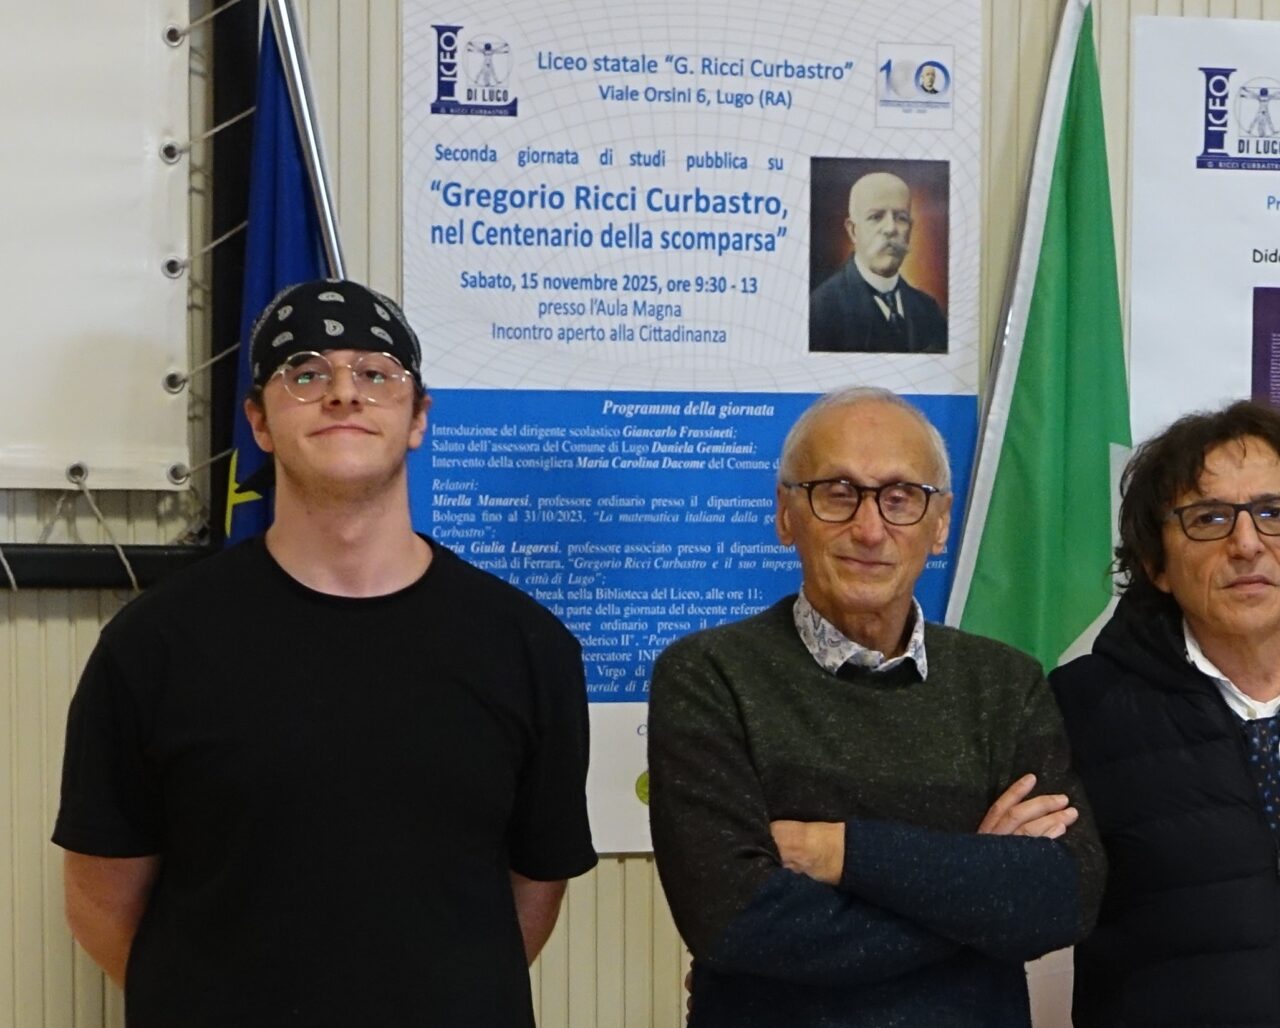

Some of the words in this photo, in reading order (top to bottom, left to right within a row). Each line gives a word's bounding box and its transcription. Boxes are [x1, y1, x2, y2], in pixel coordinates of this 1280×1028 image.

[538, 51, 588, 71] Liceo
[593, 53, 658, 74] statale
[701, 57, 744, 77] Ricci
[751, 59, 854, 80] Curbastro"
[466, 88, 477, 101] DI
[482, 88, 509, 102] LUGO
[600, 85, 640, 102] Viale
[644, 86, 691, 103] Orsini
[696, 88, 711, 106] 6,
[717, 89, 754, 108] Lugo
[759, 88, 793, 109] (RA)
[1238, 139, 1250, 154] DI
[435, 143, 497, 162] Seconda
[518, 146, 579, 167] giornata
[600, 148, 613, 165] di
[629, 150, 665, 167] studi
[686, 150, 748, 172] pubblica
[768, 157, 784, 170] su
[430, 179, 565, 214] "Gregorio
[574, 184, 637, 211] Ricci
[646, 187, 788, 220] Curbastro,
[431, 218, 464, 245] nel
[471, 220, 593, 247] Centenario
[600, 222, 653, 249] della
[660, 226, 788, 256] scomparsa"
[460, 271, 516, 292] Sabato,
[521, 272, 539, 290] 15
[543, 273, 618, 291] novembre
[622, 275, 663, 294] 2025,
[667, 278, 691, 292] ore
[695, 276, 727, 293] 9:30
[741, 277, 758, 294] 13
[538, 301, 586, 319] presso
[590, 298, 628, 317] l'Aula
[633, 300, 682, 321] Magna
[492, 323, 553, 340] Incontro
[557, 325, 606, 343] aperto
[610, 324, 634, 341] alla
[639, 325, 727, 343] Cittadinanza
[602, 401, 680, 418] Programma
[684, 401, 716, 416] della
[718, 403, 775, 419] giornata
[432, 424, 498, 437] Introduzione
[520, 425, 567, 440] dirigente
[569, 425, 620, 437] scolastico
[622, 425, 677, 439] Giancarlo
[432, 440, 465, 452] Saluto
[562, 441, 606, 453] Comune
[622, 441, 650, 456] Lugo
[651, 441, 694, 454] Daniela
[432, 455, 486, 468] Intervento
[488, 455, 514, 468] della
[516, 456, 574, 471] consigliera
[576, 456, 609, 468] Maria
[611, 456, 659, 469] Carolina
[662, 457, 706, 469] Dacome
[727, 458, 771, 470] Comune
[432, 478, 479, 491] Relatori:
[432, 494, 471, 507] Mirella
[538, 495, 592, 509] professore
[597, 495, 645, 507] ordinario
[651, 497, 685, 511] presso
[707, 496, 773, 511] dipartimento
[432, 510, 476, 526] Bologna
[618, 511, 680, 523] matematica
[685, 511, 726, 523] italiana
[471, 541, 505, 554] Giulia
[624, 542, 672, 554] associato
[677, 545, 711, 557] presso
[653, 557, 707, 570] Curbastro
[567, 588, 594, 600] nella
[596, 588, 649, 600] Biblioteca
[623, 604, 666, 618] giornata
